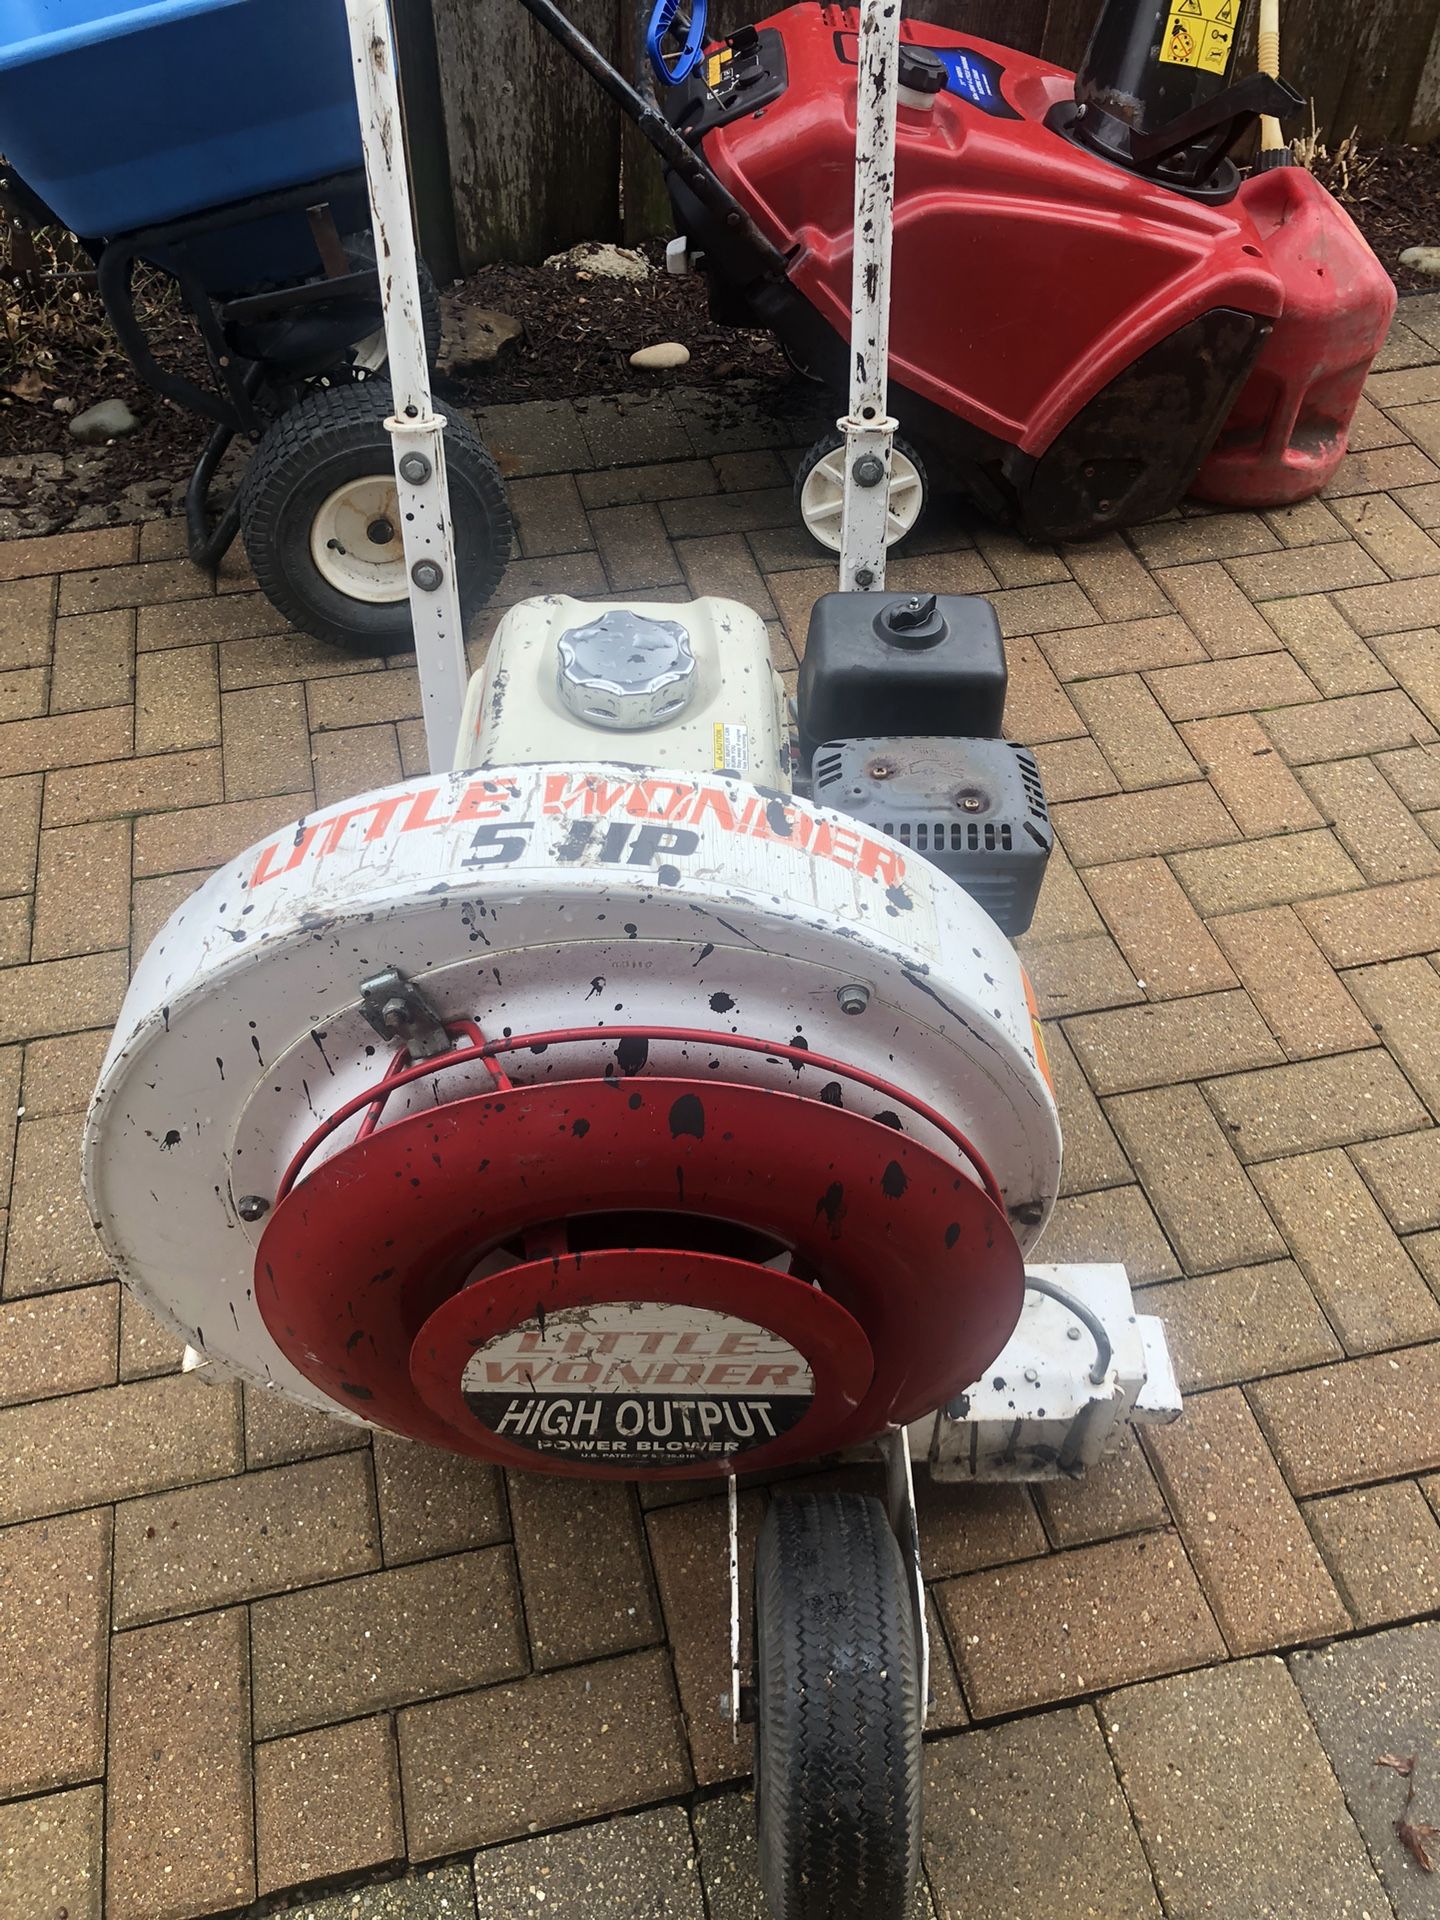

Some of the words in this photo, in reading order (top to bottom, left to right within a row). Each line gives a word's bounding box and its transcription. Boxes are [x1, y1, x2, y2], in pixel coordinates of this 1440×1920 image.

[715, 729, 723, 754] CAUTION
[247, 777, 517, 888] LITTLE
[543, 775, 905, 888] WONDER
[461, 822, 535, 867] 5
[557, 821, 700, 864] HP
[517, 1331, 763, 1356] LITTLE
[485, 1361, 800, 1386] WONDER
[496, 1399, 603, 1436] HIGH
[615, 1400, 778, 1437] OUTPUT
[538, 1439, 628, 1451] POWER
[636, 1441, 740, 1452] BLOWER
